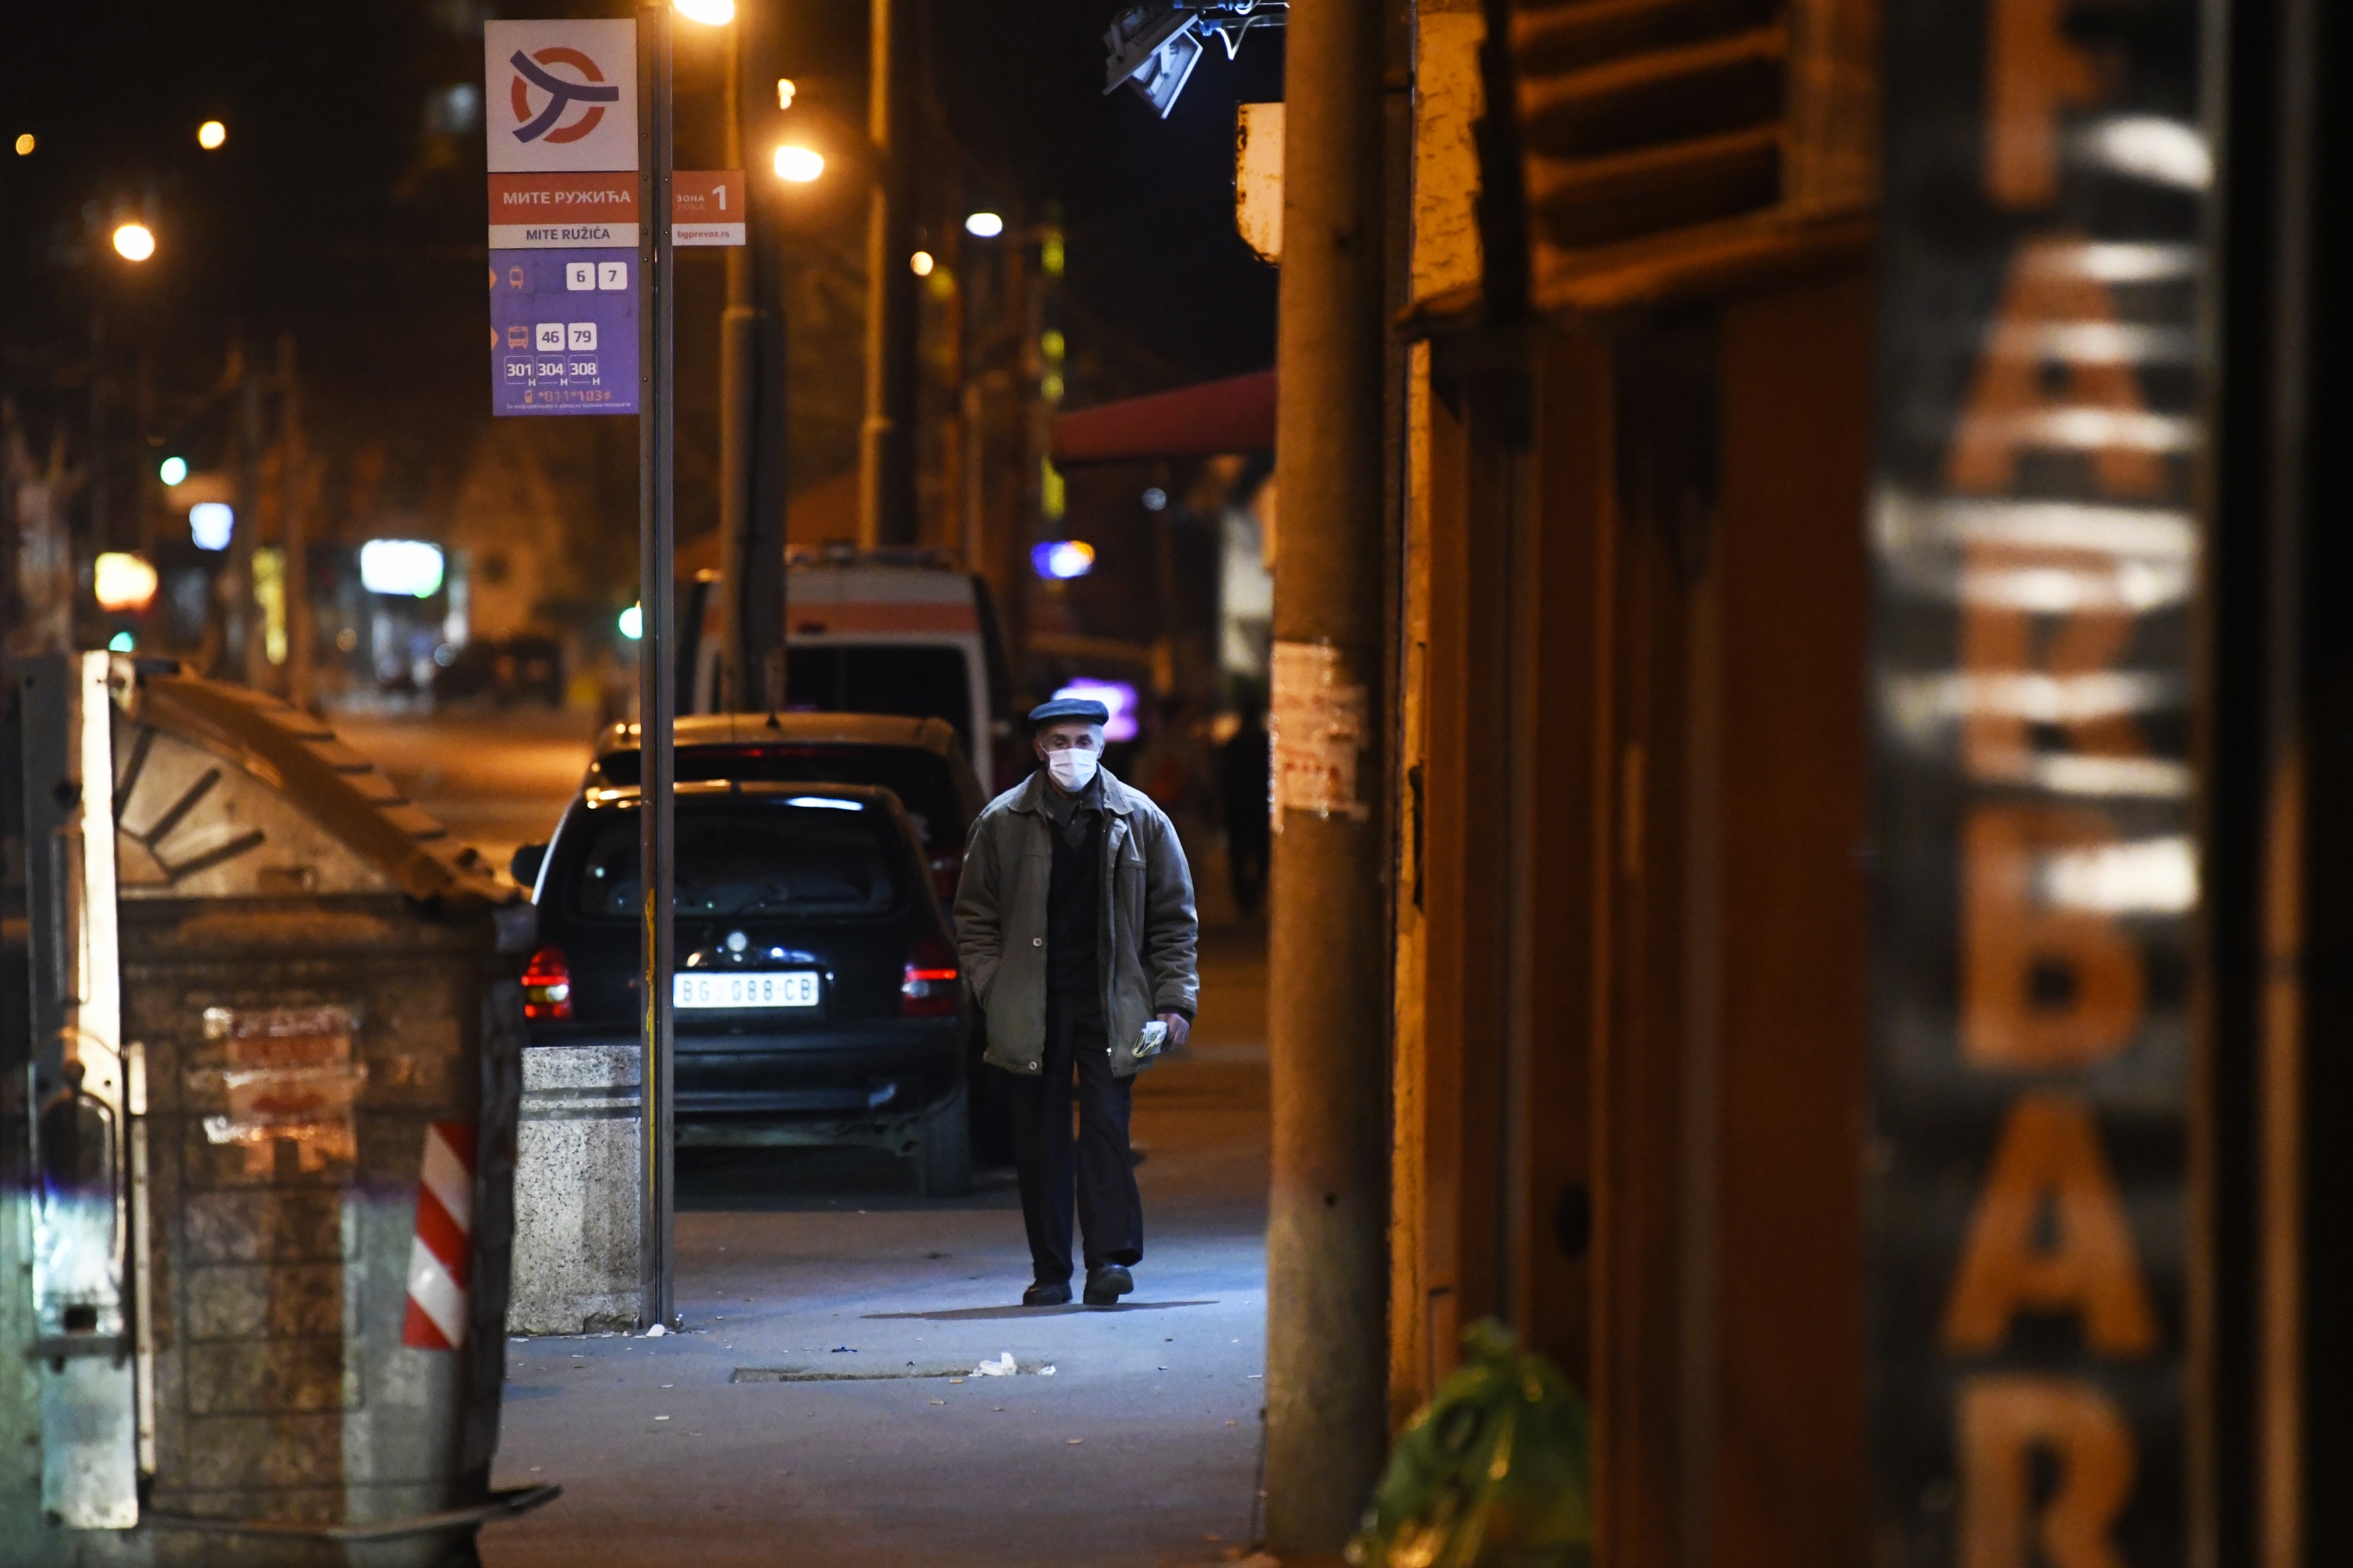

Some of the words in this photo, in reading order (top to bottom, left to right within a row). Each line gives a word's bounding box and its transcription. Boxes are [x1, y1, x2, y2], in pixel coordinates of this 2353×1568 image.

[503, 191, 550, 205] МИТЕ
[555, 190, 631, 204] РУЖИЋА
[676, 195, 705, 203] ЗОНА
[712, 184, 726, 211] 1
[526, 229, 558, 240] MITE
[562, 226, 611, 240] RUŽIĆA
[677, 230, 730, 240] bgprevoz.rs
[576, 270, 585, 283] 6
[608, 270, 617, 282] 7
[541, 331, 560, 343] 46
[573, 330, 591, 343] 79
[507, 363, 532, 376] 301
[537, 363, 564, 376] 304
[570, 362, 597, 376] 308
[683, 980, 710, 1003] BG
